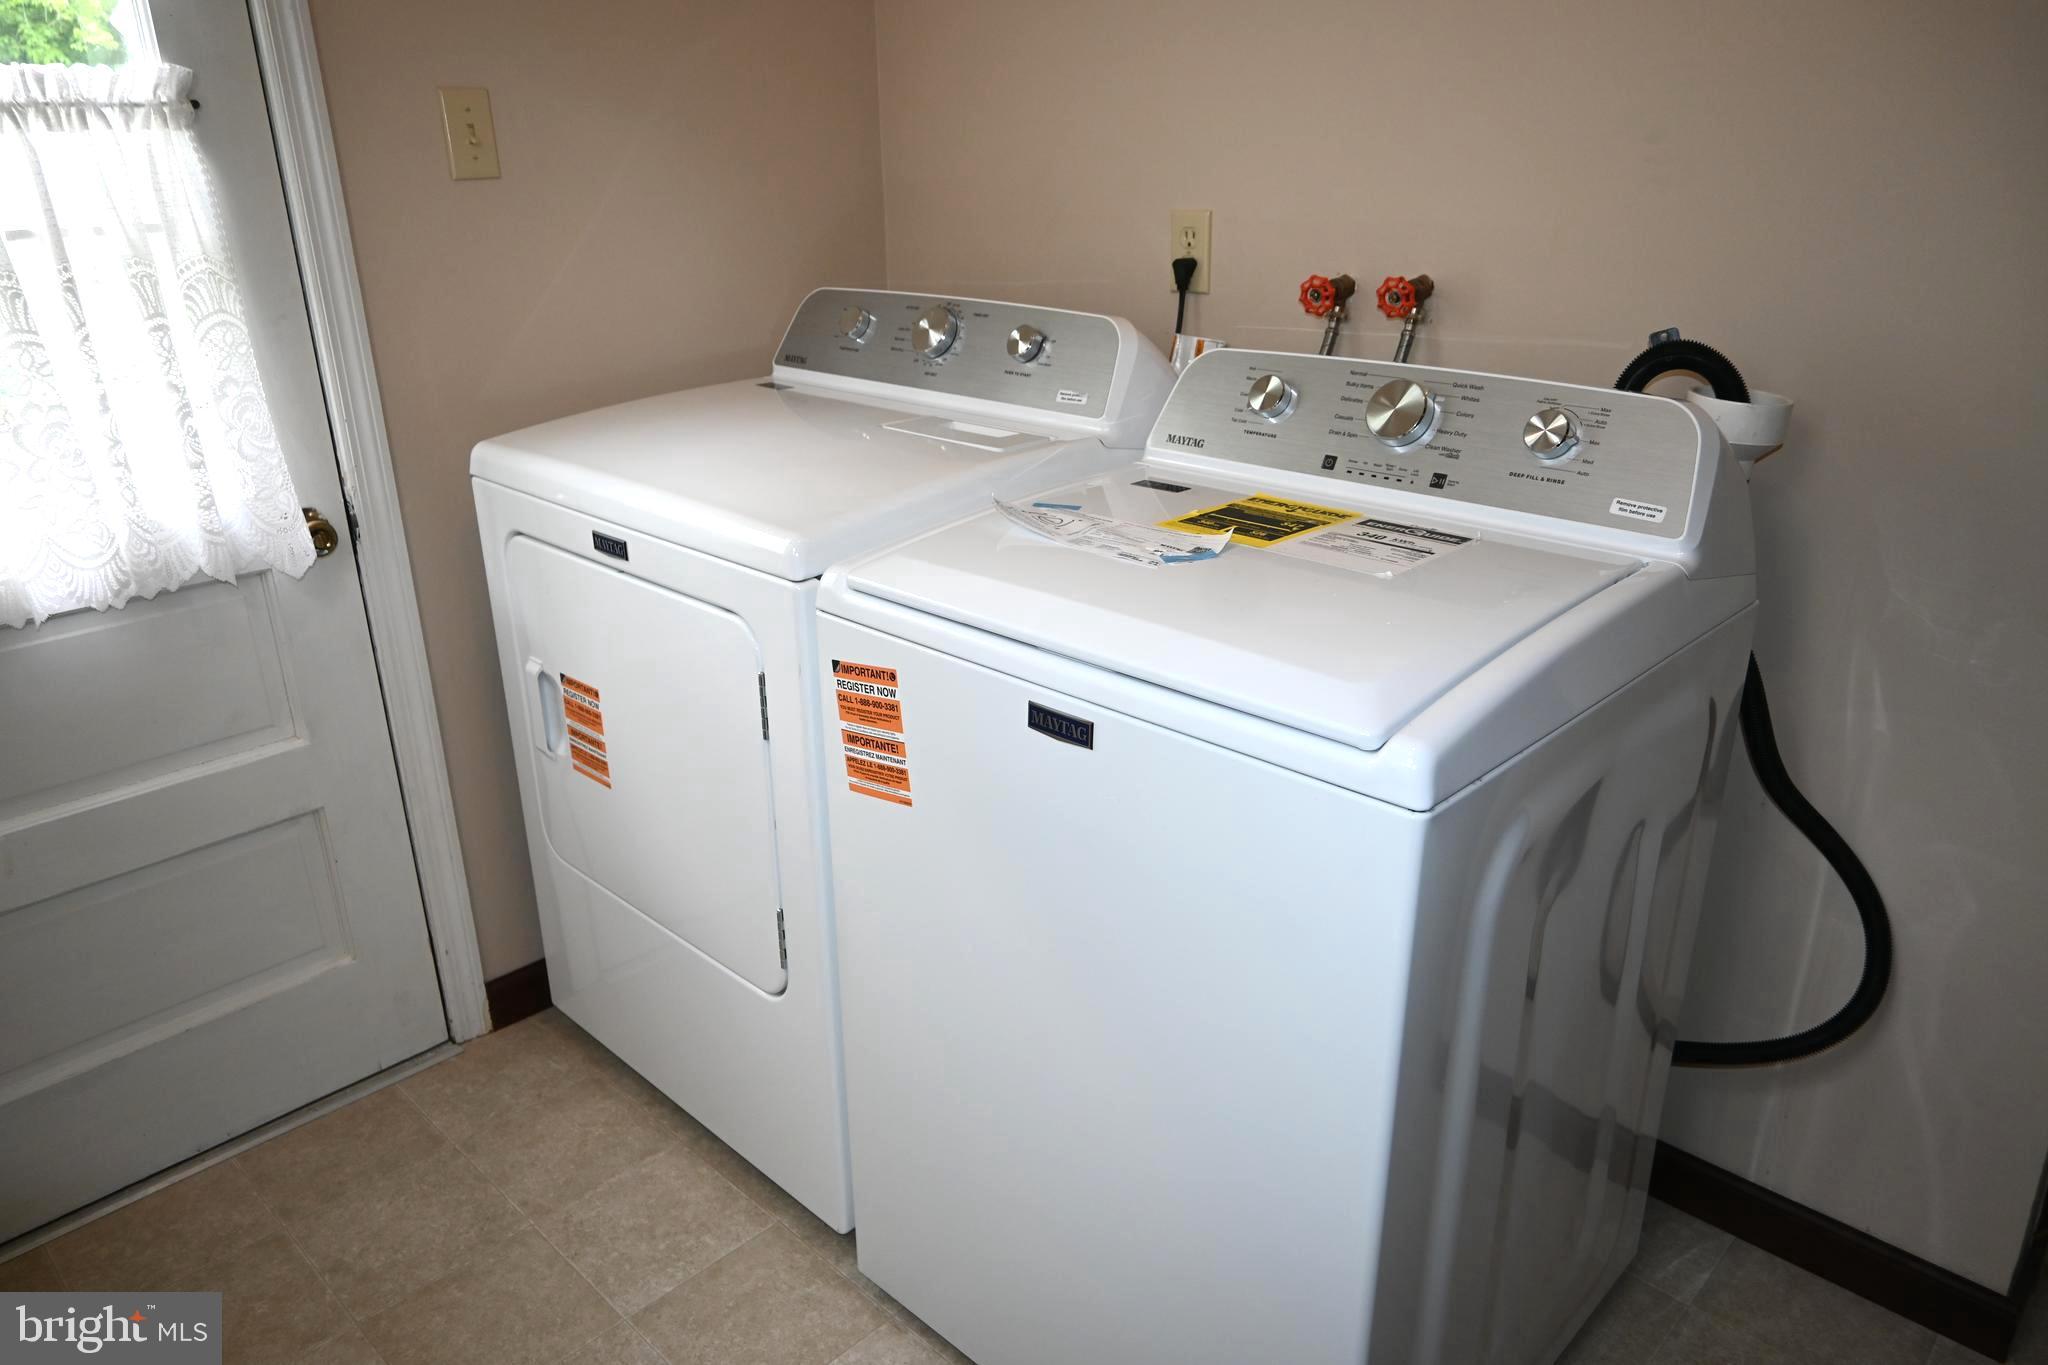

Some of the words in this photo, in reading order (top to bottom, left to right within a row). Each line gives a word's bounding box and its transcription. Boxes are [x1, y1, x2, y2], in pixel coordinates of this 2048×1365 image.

[1345, 380, 1359, 388] Bulky
[1340, 396, 1364, 404] Delicates
[1244, 430, 1277, 438] TEMPERATURE
[1328, 428, 1342, 436] Drain
[1436, 428, 1453, 436] Heavy
[1454, 430, 1468, 438] Duty
[1166, 434, 1205, 448] MAYTAG
[1441, 446, 1462, 454] Washer
[1508, 471, 1525, 480] DEEP
[1616, 500, 1637, 508] Remove
[1637, 504, 1663, 514] protective
[1356, 532, 1387, 540] 340
[841, 664, 890, 681] IMPORTANT!
[836, 679, 875, 695] REGISTER
[876, 686, 897, 698] NOW
[563, 688, 587, 704] REGISTER
[588, 698, 600, 710] NOW
[838, 694, 854, 704] CALL
[1031, 710, 1087, 741] MAYTAG
[846, 734, 899, 754] IMPORTANTE!
[844, 746, 875, 759] ENREGISTREZ
[876, 754, 906, 766] MAINTENANT
[847, 756, 866, 767] APPELEZ
